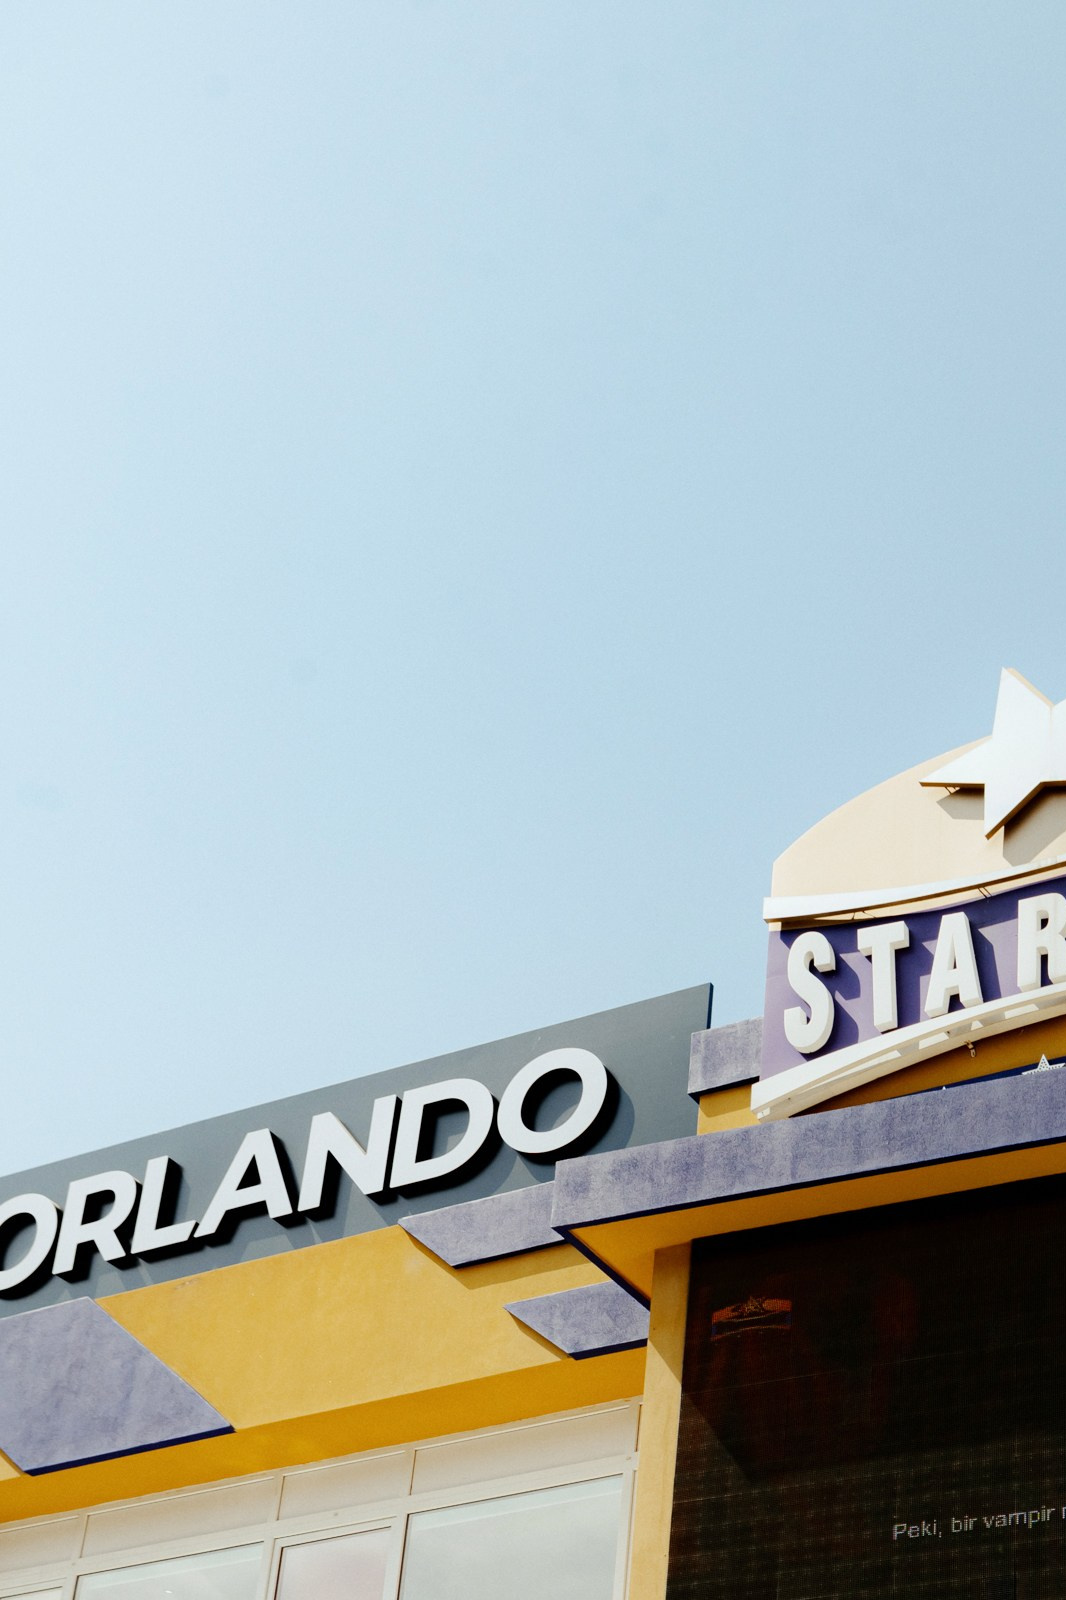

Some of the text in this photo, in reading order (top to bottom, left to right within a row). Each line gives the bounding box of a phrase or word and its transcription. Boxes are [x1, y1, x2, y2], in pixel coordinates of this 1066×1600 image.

[0, 1047, 608, 1293] ORLANDO
[893, 1520, 943, 1540] Peki,
[952, 1516, 977, 1533] bir
[983, 1505, 1056, 1529] vampir
